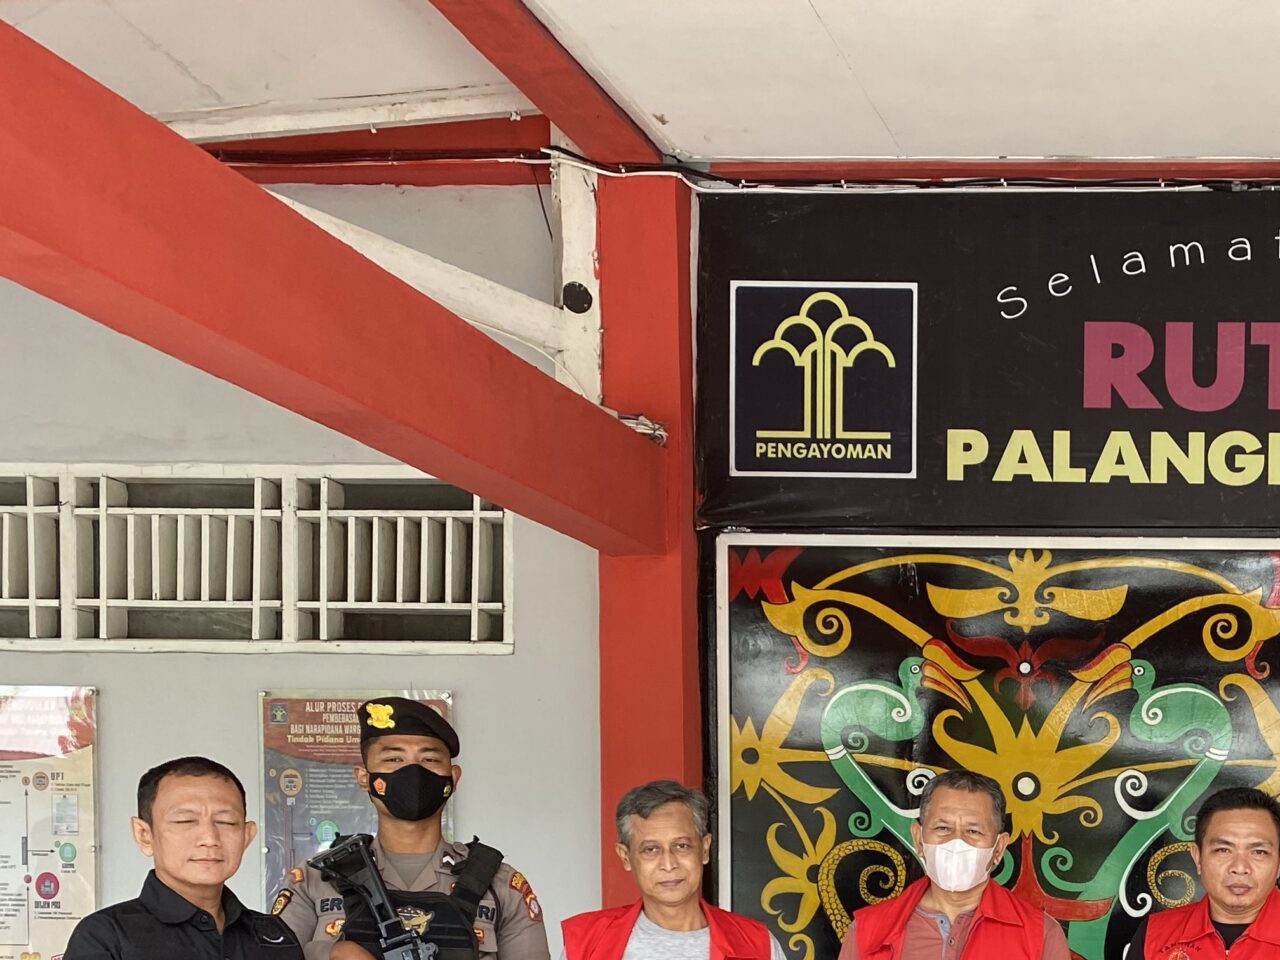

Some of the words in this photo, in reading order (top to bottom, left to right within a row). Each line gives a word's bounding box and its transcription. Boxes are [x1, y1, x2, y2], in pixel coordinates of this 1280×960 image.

[755, 443, 892, 459] PENGAYOMAN
[305, 702, 325, 712] ALUR
[326, 702, 356, 712] PROSES
[322, 713, 359, 723] PEMBEBASA
[290, 724, 305, 734] BAGI
[305, 724, 343, 734] NARAPIDANA
[344, 724, 361, 734] WARG
[316, 735, 344, 743] Pidana
[346, 735, 361, 743] Um
[320, 897, 343, 913] ER
